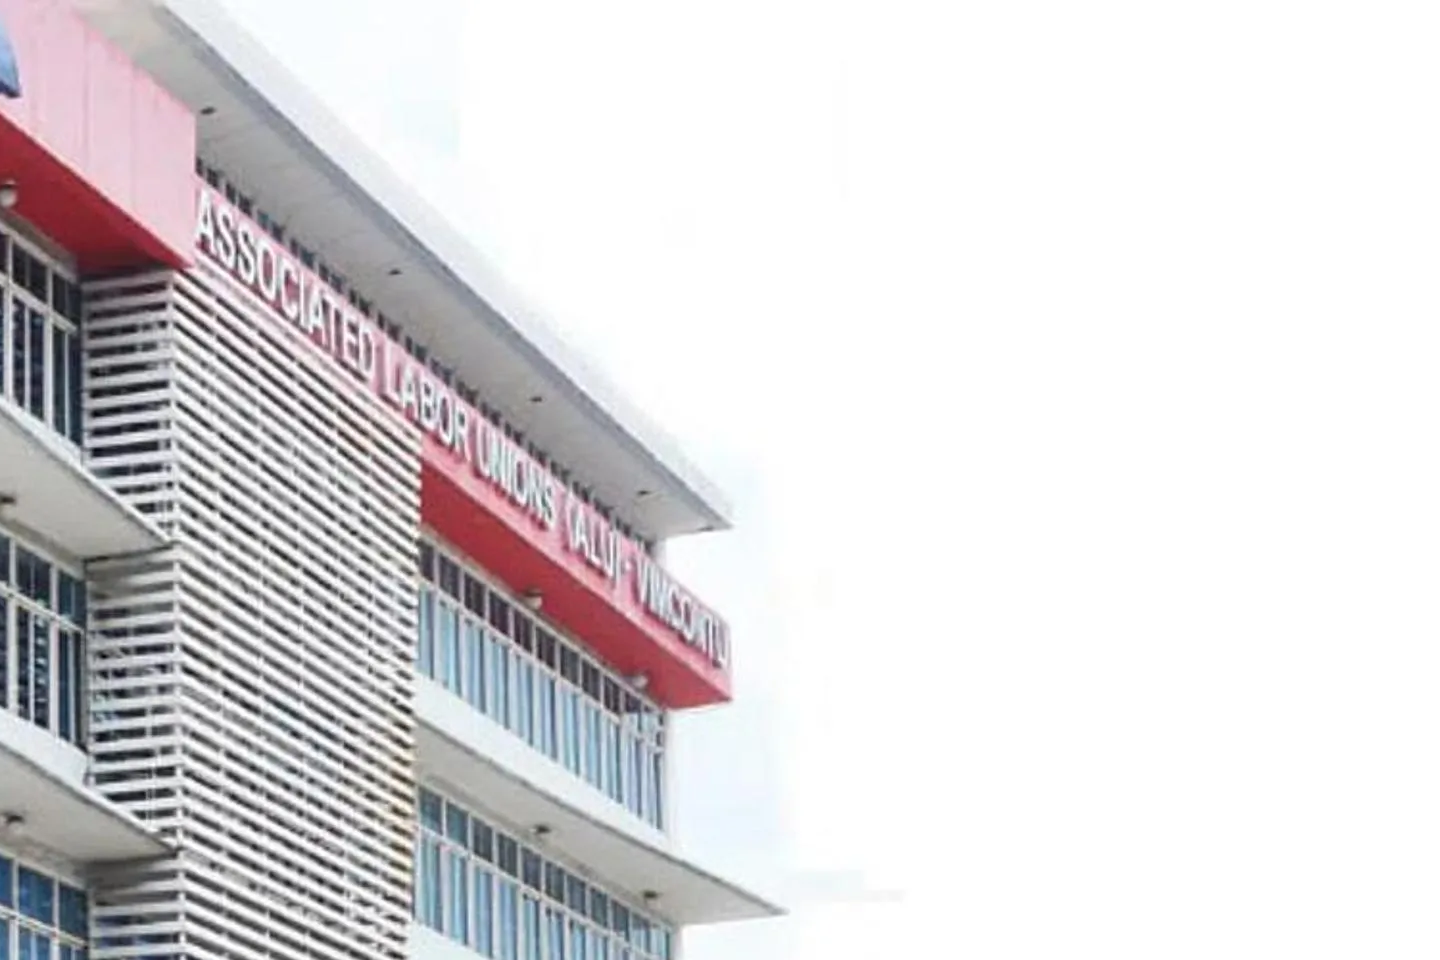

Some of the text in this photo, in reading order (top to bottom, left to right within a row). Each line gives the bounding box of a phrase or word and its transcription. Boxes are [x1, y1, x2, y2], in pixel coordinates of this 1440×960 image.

[194, 187, 376, 373] ASSOCIATED
[384, 341, 472, 463] LABOR
[477, 416, 558, 529] UNIONS
